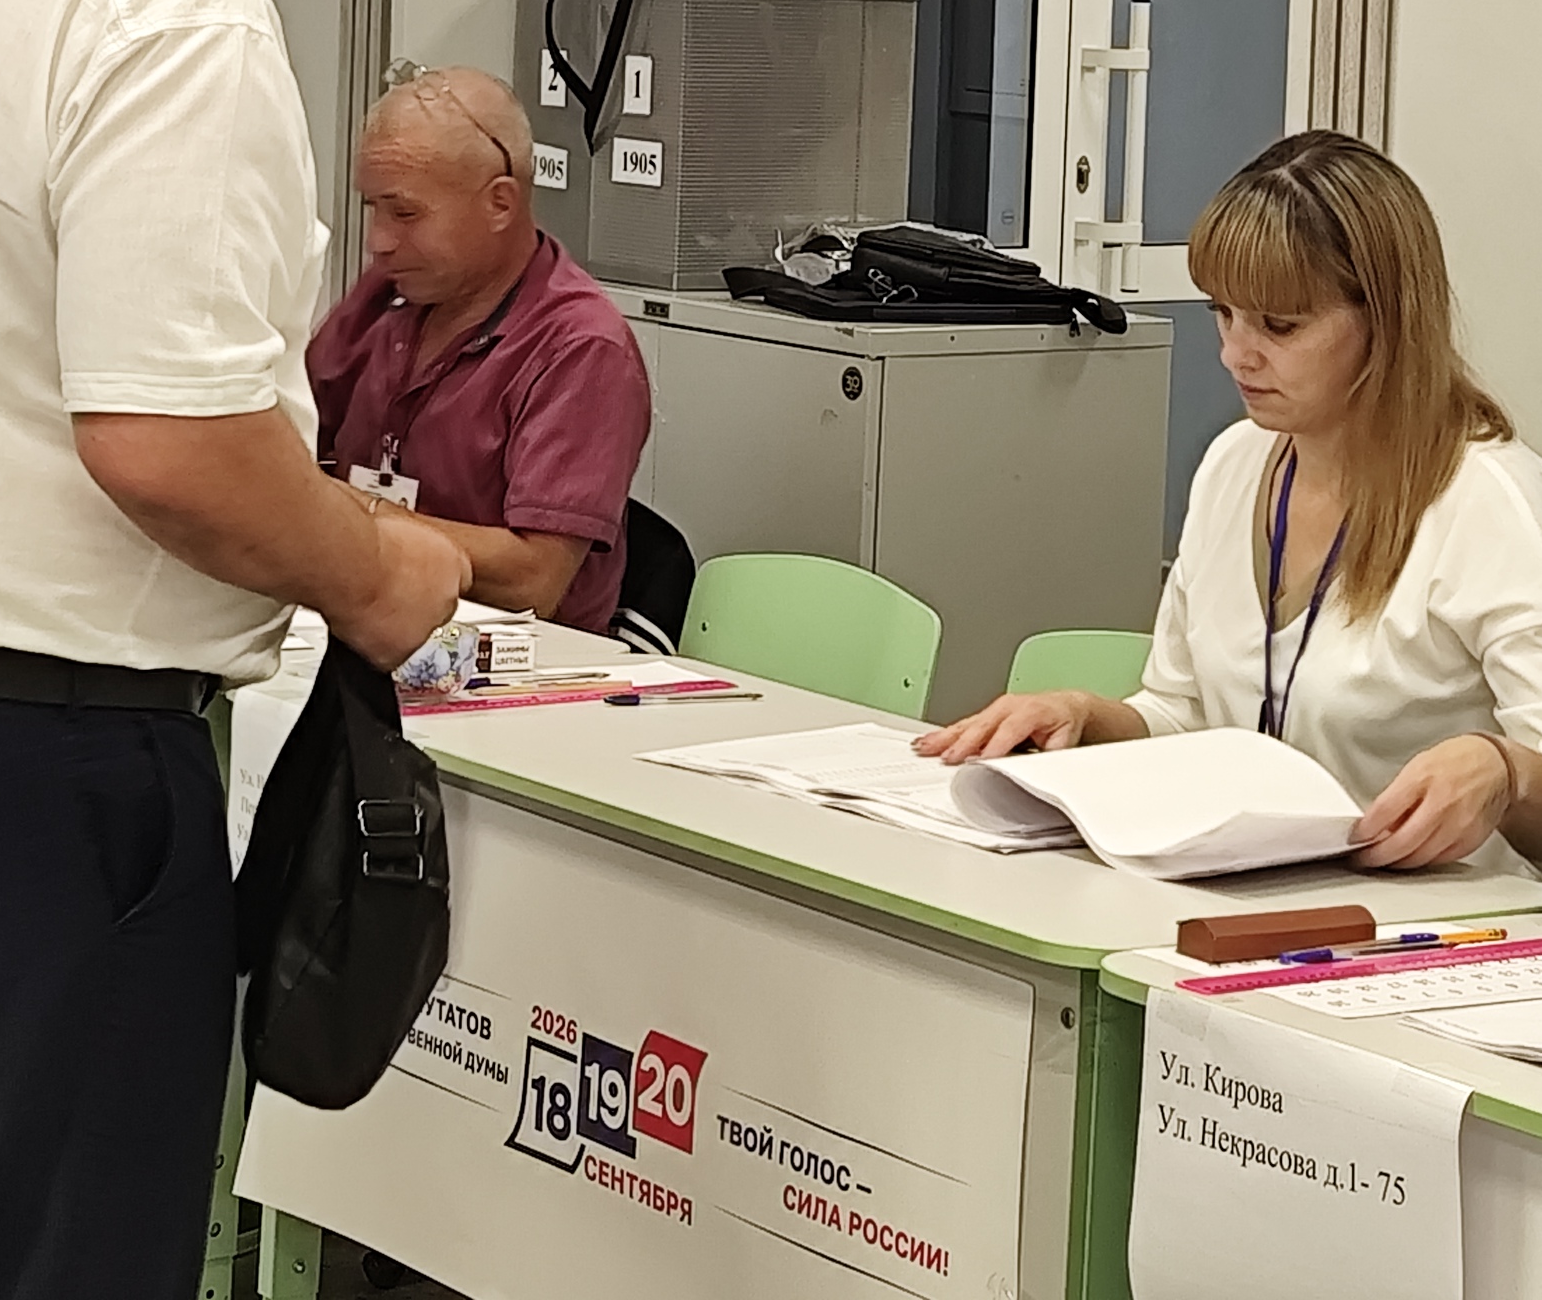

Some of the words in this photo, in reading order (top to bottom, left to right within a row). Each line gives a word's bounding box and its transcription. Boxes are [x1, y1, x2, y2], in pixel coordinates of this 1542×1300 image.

[633, 69, 641, 99] 1
[533, 154, 564, 181] 1905
[622, 151, 657, 175] 1905
[421, 996, 492, 1040] УТАТОВ
[530, 1005, 578, 1044] 2026
[465, 1048, 509, 1085] ДУМЫ
[583, 1061, 628, 1131] 19
[637, 1052, 693, 1127] 20
[1159, 1050, 1195, 1089] Ул.
[1203, 1063, 1284, 1114] Кирова
[531, 1075, 572, 1142] 18
[716, 1113, 774, 1161] ТВОЙ
[778, 1140, 851, 1193] ГОЛОС
[1157, 1104, 1193, 1142] Ул.
[1200, 1116, 1318, 1181] Некрасова
[1377, 1170, 1407, 1206] 75
[583, 1154, 694, 1227] СЕНТЯБРЯ
[782, 1184, 843, 1232] СИЛА
[848, 1214, 950, 1278] РОССИИ!
